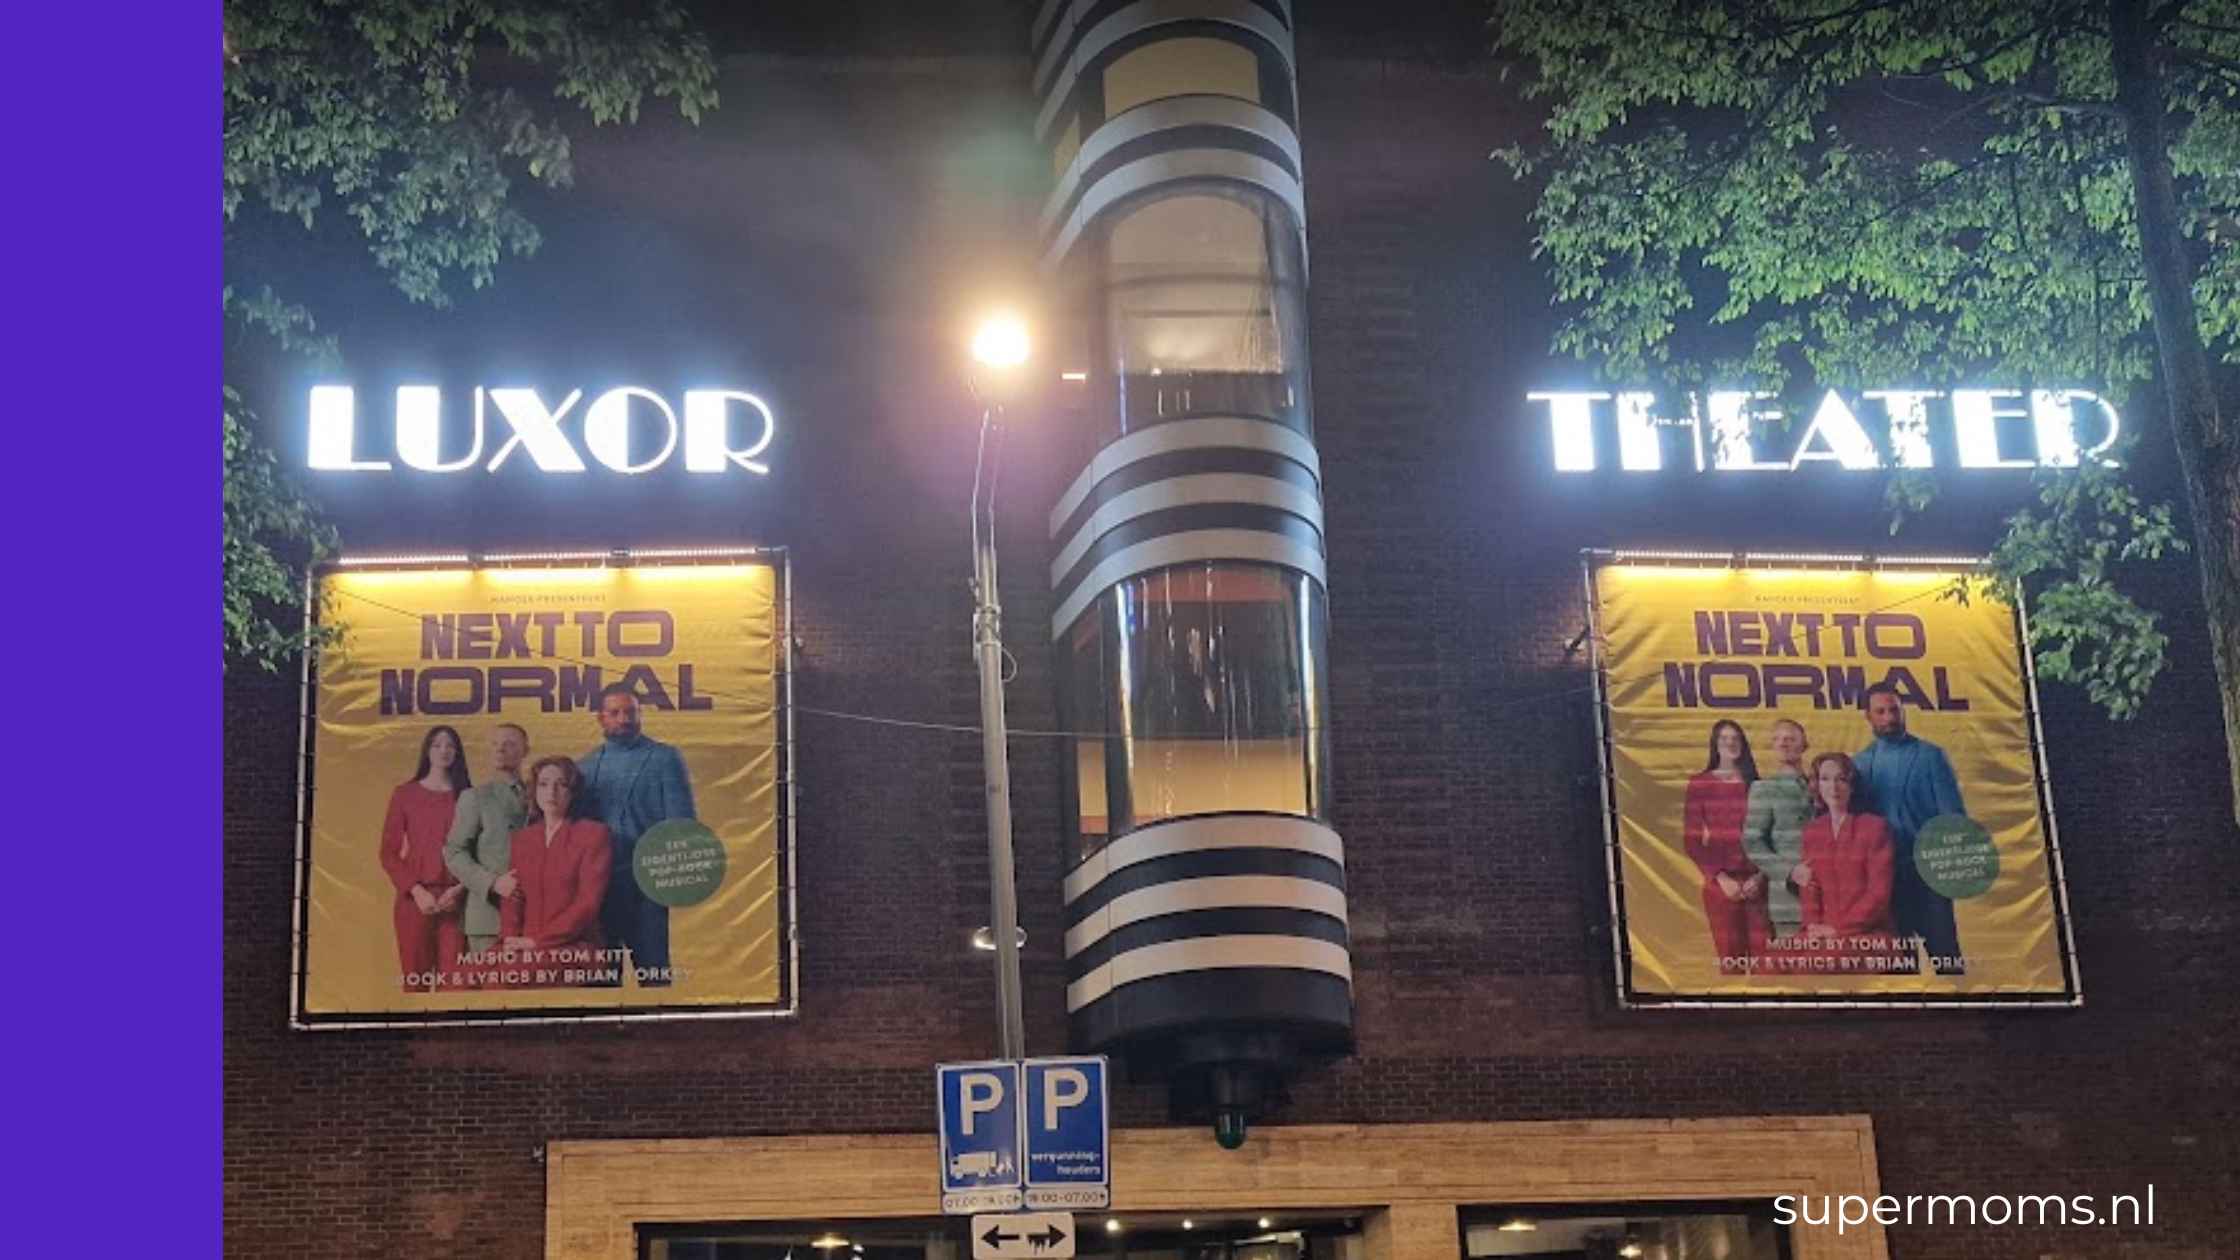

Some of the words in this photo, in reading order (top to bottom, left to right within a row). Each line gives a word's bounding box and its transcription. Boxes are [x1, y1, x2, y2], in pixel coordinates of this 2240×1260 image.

[307, 385, 775, 474] LUXOR
[1526, 387, 2121, 472] THEATER
[420, 612, 564, 660] NEXT
[574, 610, 675, 657] TO
[1694, 610, 1823, 657] NEXT
[1832, 613, 1927, 659] TO
[379, 663, 713, 715] NORMAL
[1663, 661, 1970, 711] NORMAL
[456, 951, 517, 966] MUSIC
[522, 949, 543, 963] BY
[550, 949, 591, 963] TOM
[1766, 938, 1819, 951] MUSIC
[1826, 938, 1845, 951] BY
[1849, 938, 1886, 951] TOM
[1841, 956, 1859, 970] BY
[1864, 956, 1916, 970] BRIAN
[467, 969, 530, 985] LYRICS
[536, 968, 558, 983] BY
[563, 967, 618, 982] BRIAN
[960, 1073, 1004, 1135] P
[1044, 1067, 1089, 1130] P
